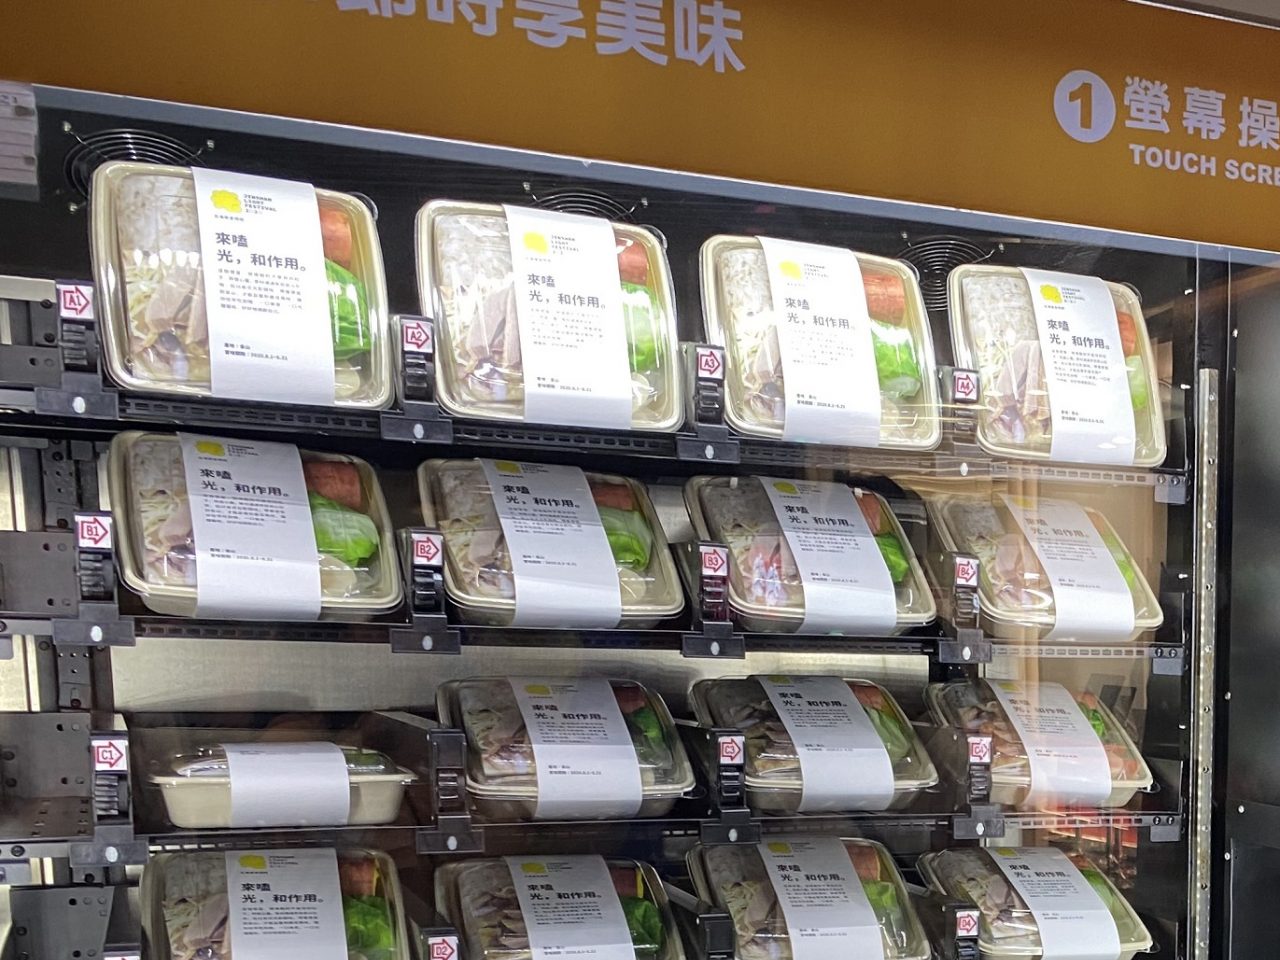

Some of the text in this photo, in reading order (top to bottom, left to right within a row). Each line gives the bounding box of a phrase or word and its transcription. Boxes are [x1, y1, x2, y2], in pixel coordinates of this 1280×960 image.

[1129, 143, 1217, 176] TOUCH
[216, 232, 248, 248] 來嗑
[528, 273, 556, 288] 來嗑
[67, 294, 83, 308] A1
[409, 330, 425, 344] A2
[702, 356, 717, 370] A3
[956, 378, 971, 394] A4
[199, 468, 232, 481] 來嗑
[87, 525, 99, 537] B1
[419, 544, 432, 555] B2
[707, 555, 719, 567] B3
[101, 749, 114, 761] C1
[435, 945, 448, 956] D2
